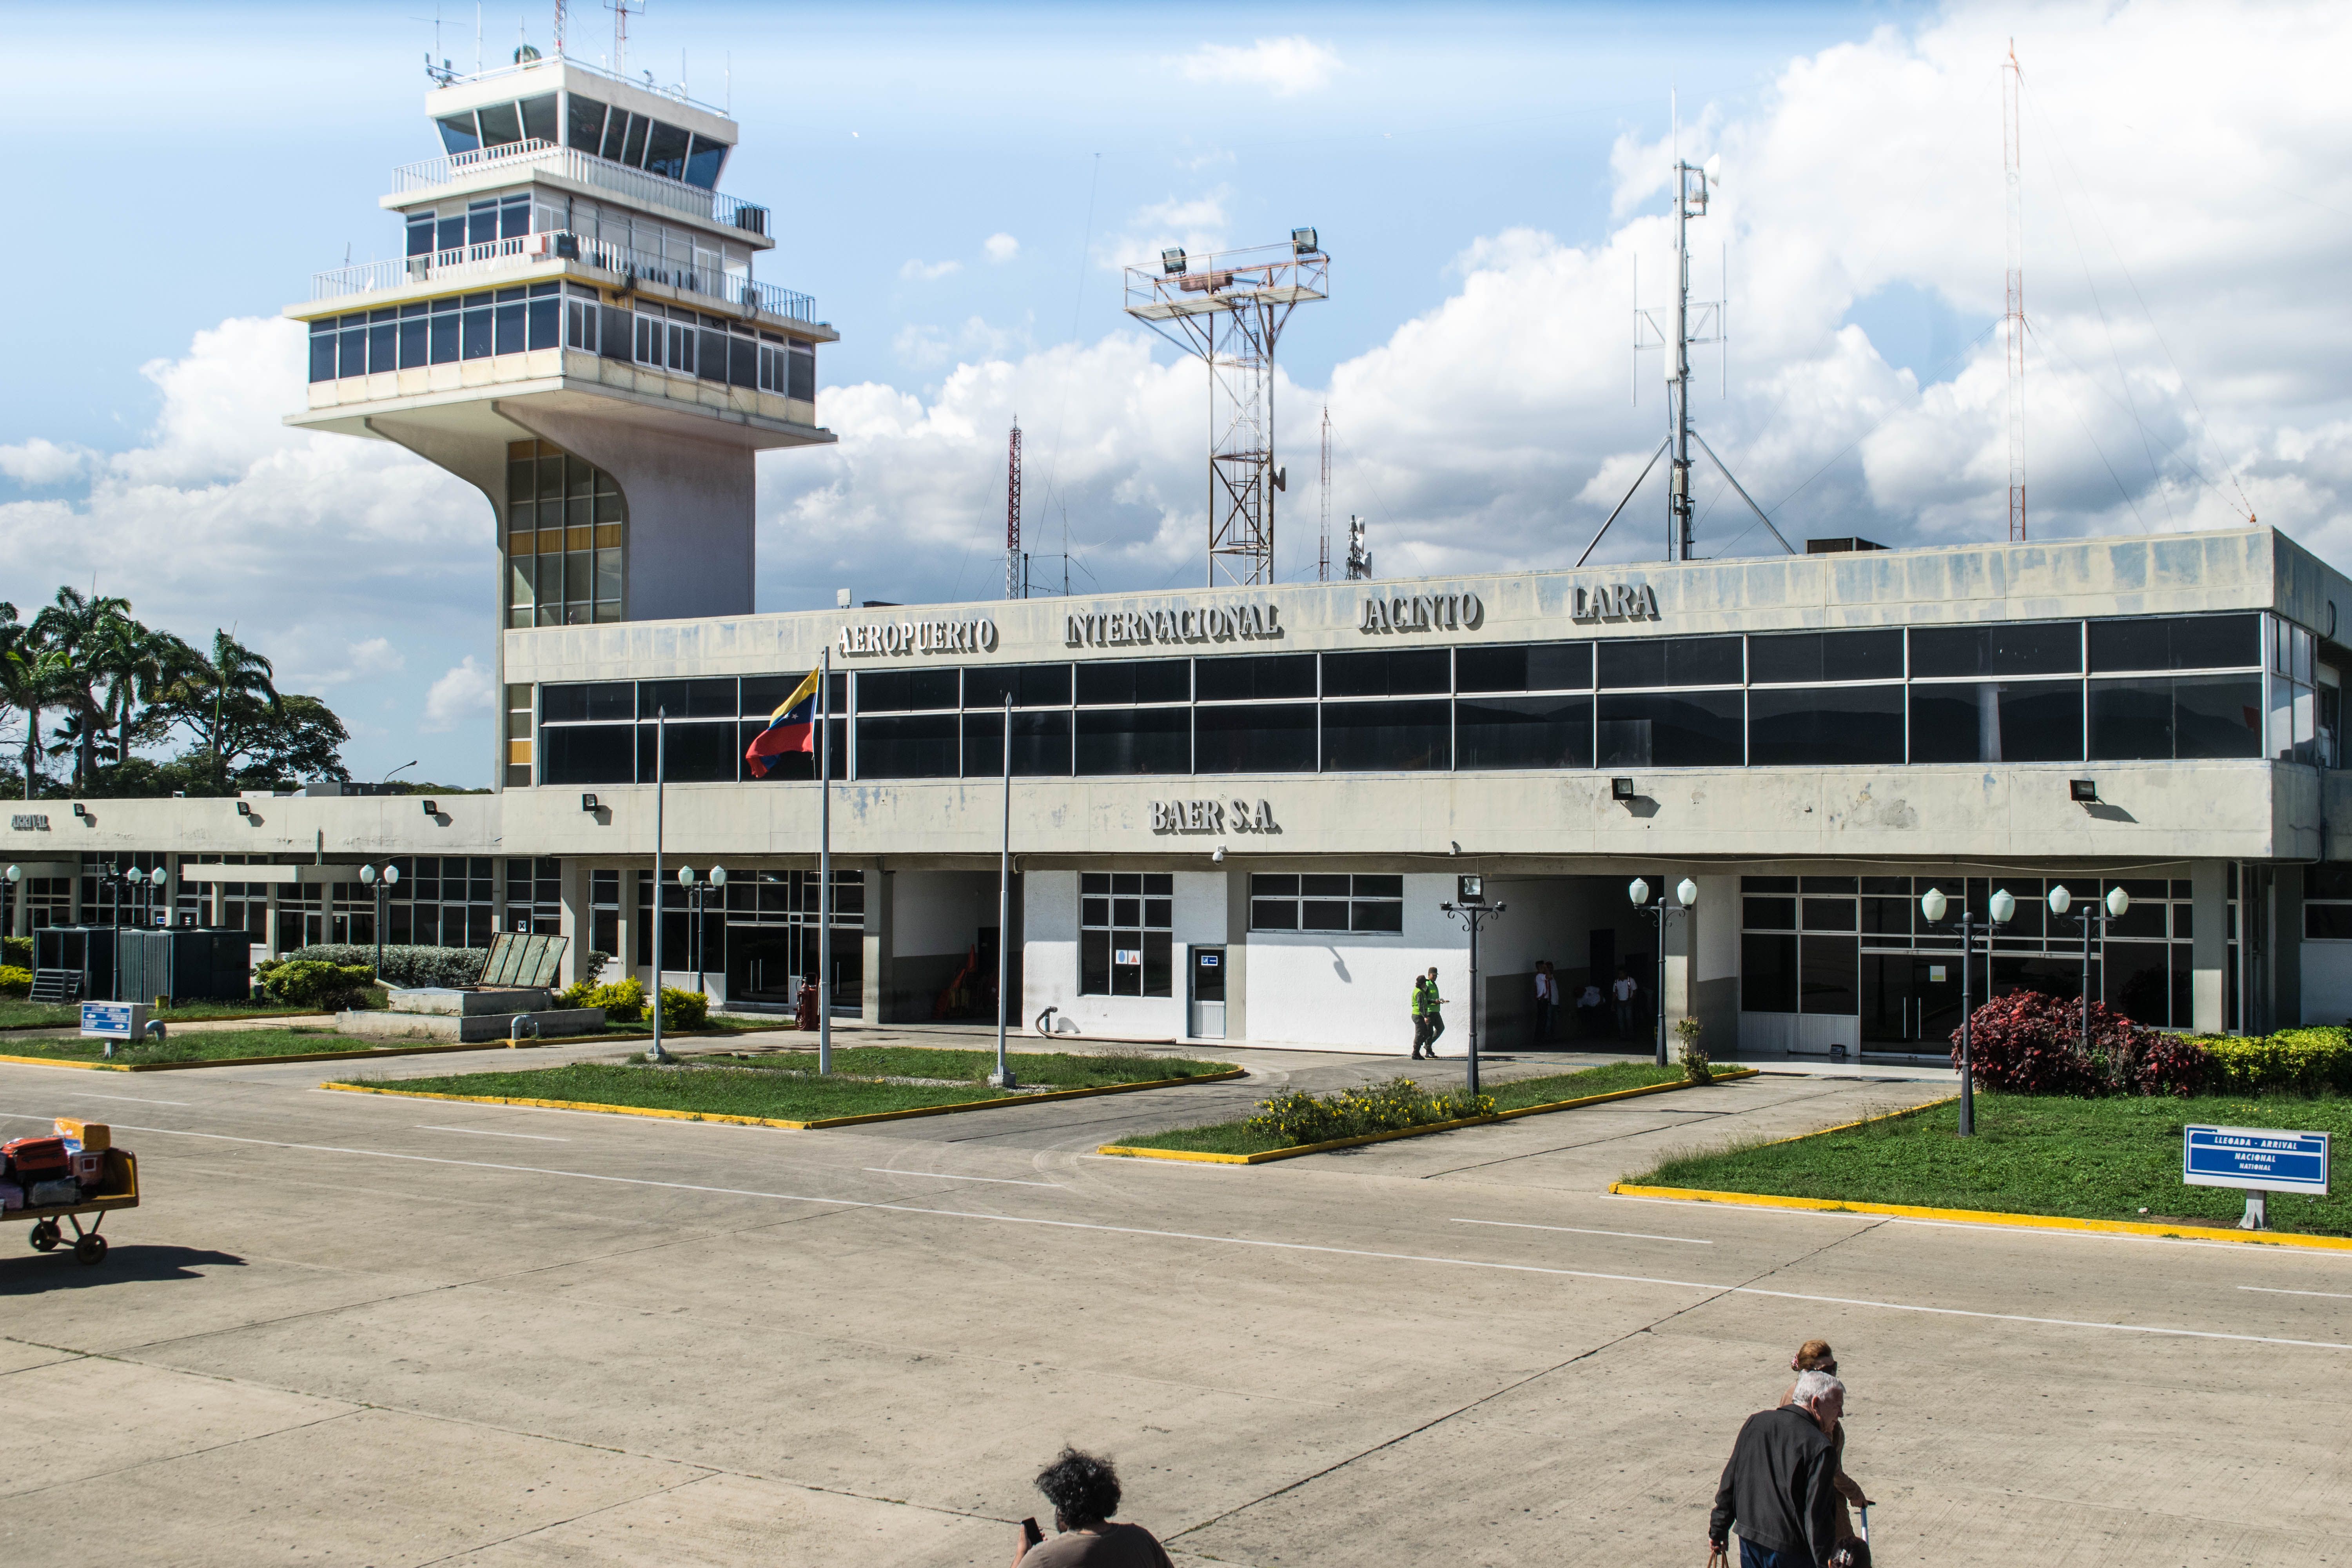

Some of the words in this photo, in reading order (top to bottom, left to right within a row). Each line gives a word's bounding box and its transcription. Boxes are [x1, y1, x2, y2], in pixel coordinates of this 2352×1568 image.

[839, 618, 993, 653] AEROPUERTO
[1067, 604, 1279, 643] INTERNACIONAL
[1358, 593, 1477, 629] JACINTO
[1569, 583, 1655, 618] LARA
[1149, 799, 1220, 829] BAER
[1229, 798, 1277, 829] S.A.
[11, 815, 47, 827] ARRIVAL
[2214, 1136, 2251, 1146] LLEGADA
[2261, 1140, 2297, 1150] ARRIVAL
[2235, 1152, 2276, 1163] NACIONAL
